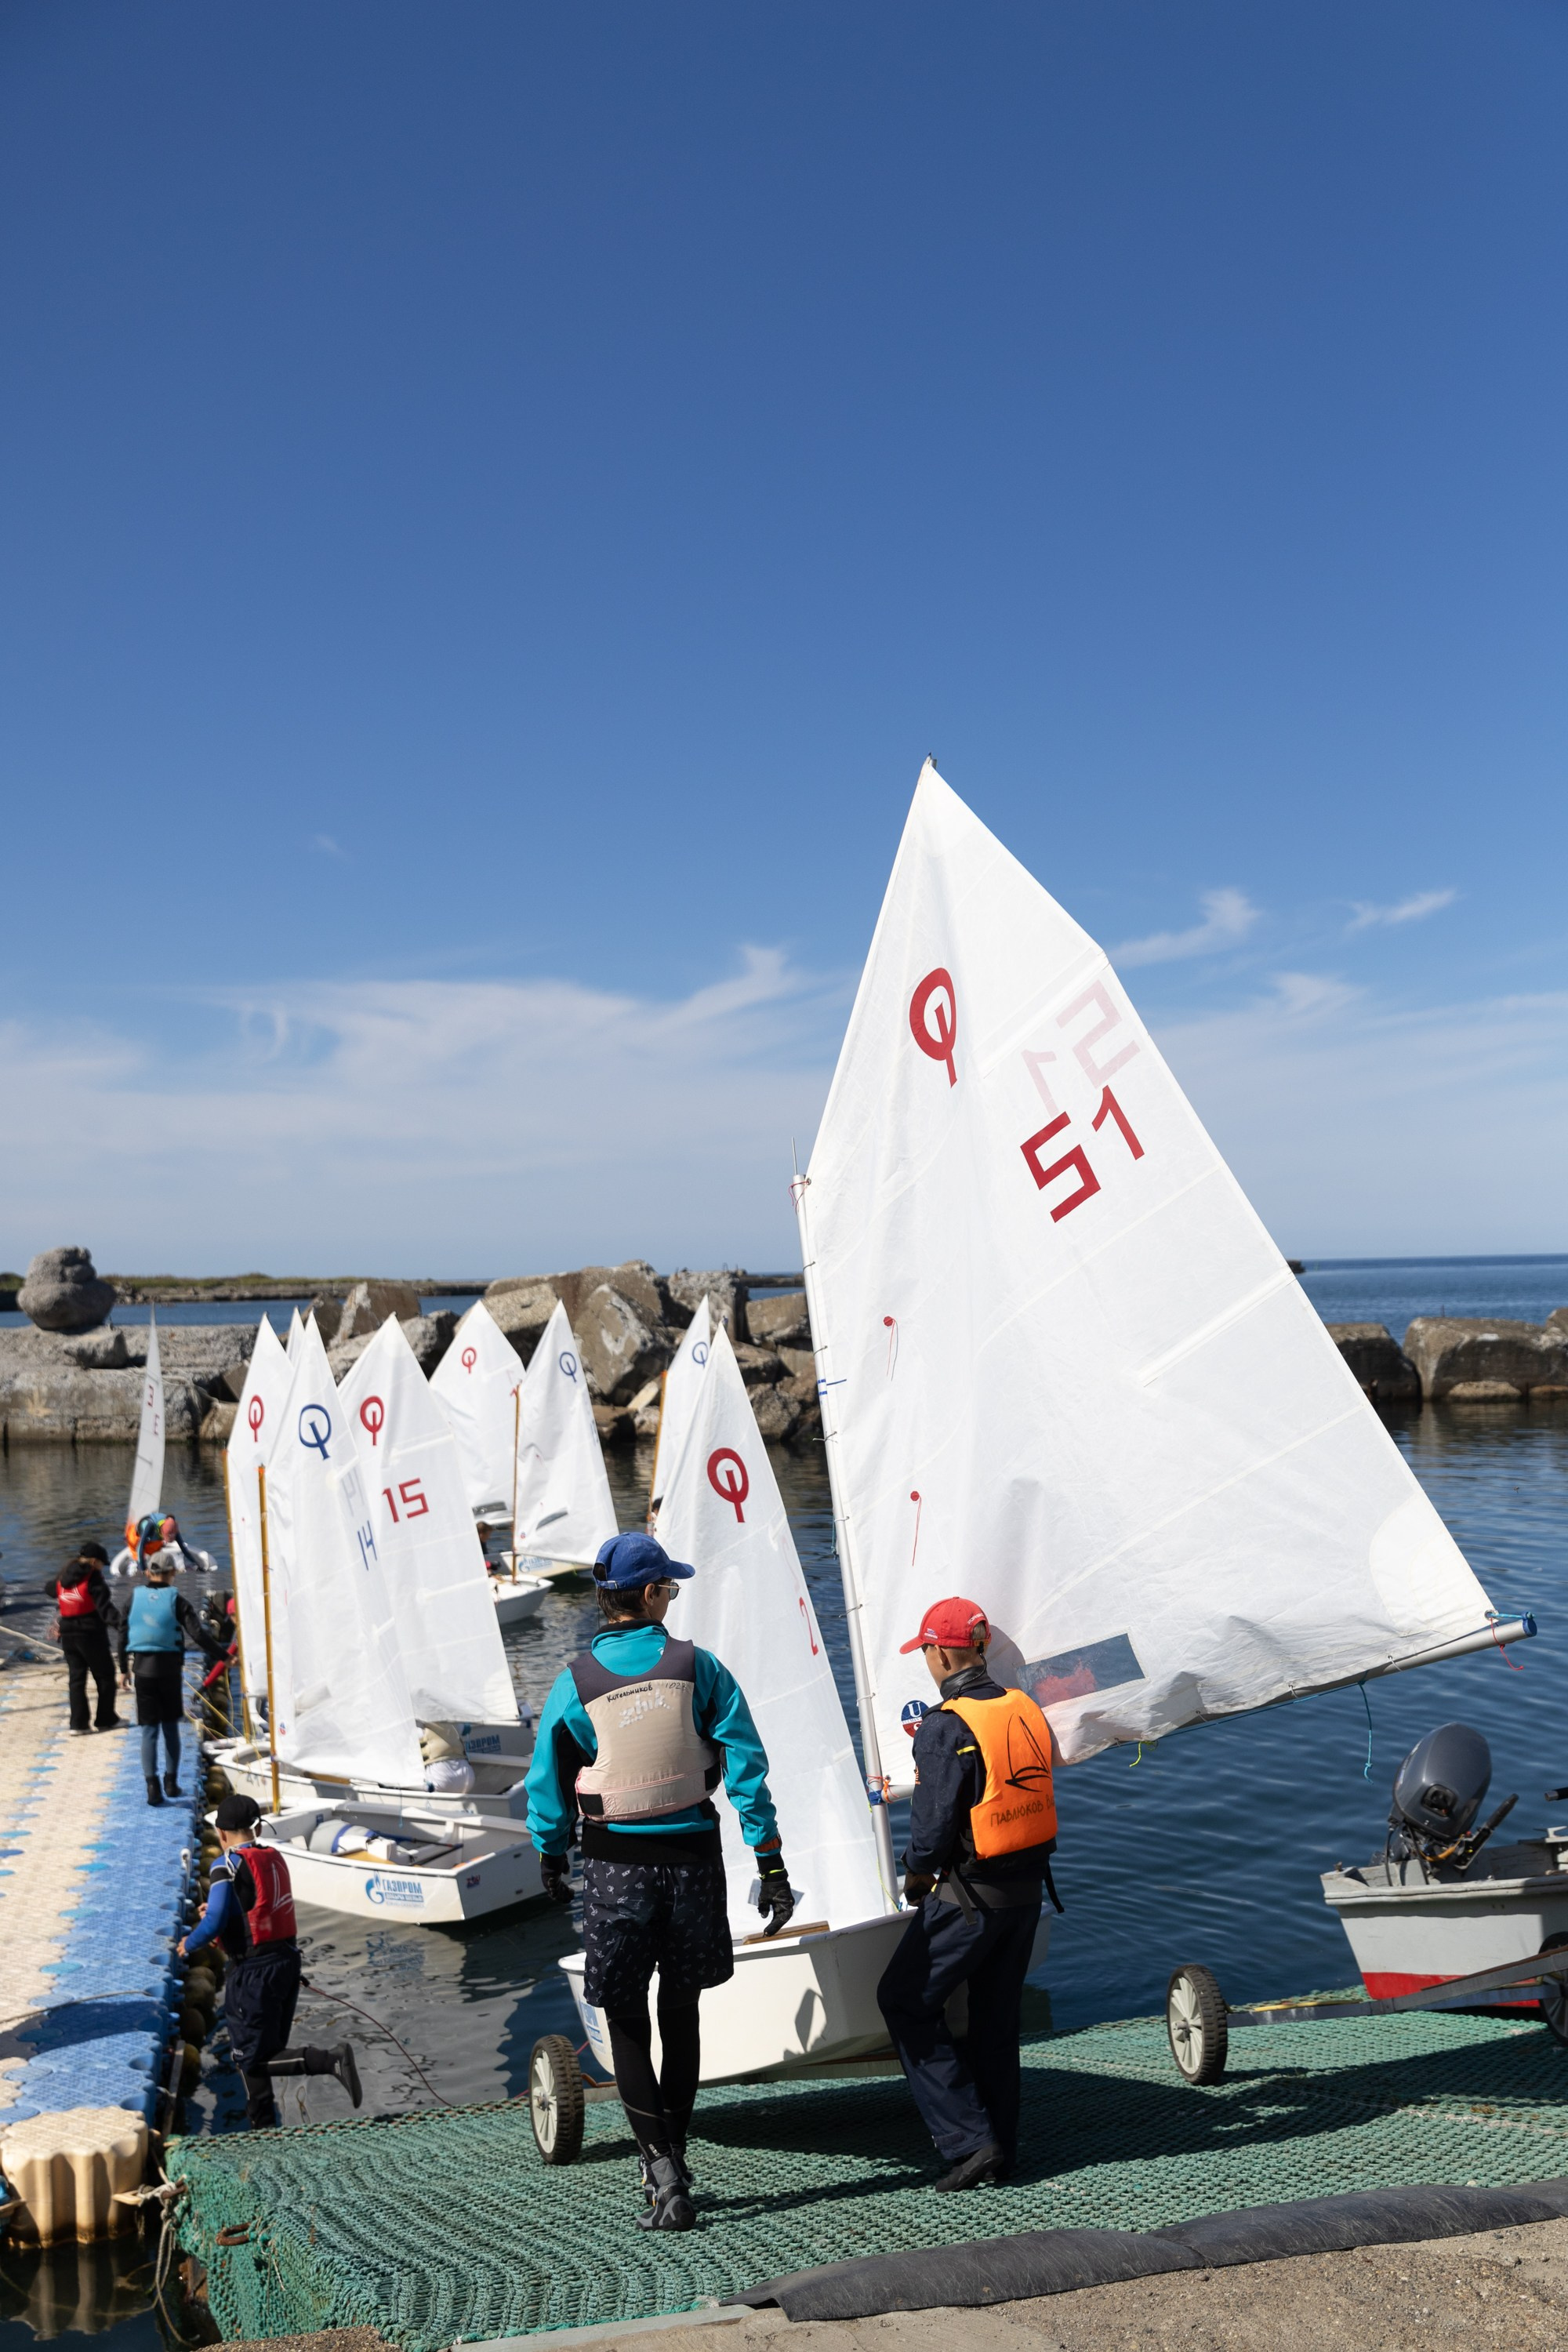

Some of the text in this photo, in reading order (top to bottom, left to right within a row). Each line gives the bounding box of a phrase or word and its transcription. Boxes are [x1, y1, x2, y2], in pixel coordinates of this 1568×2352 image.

[1019, 1084, 1145, 1224] 51
[382, 1477, 430, 1523] 15
[357, 1519, 378, 1572] 14
[382, 1878, 423, 1894] ГАЗПРОМ
